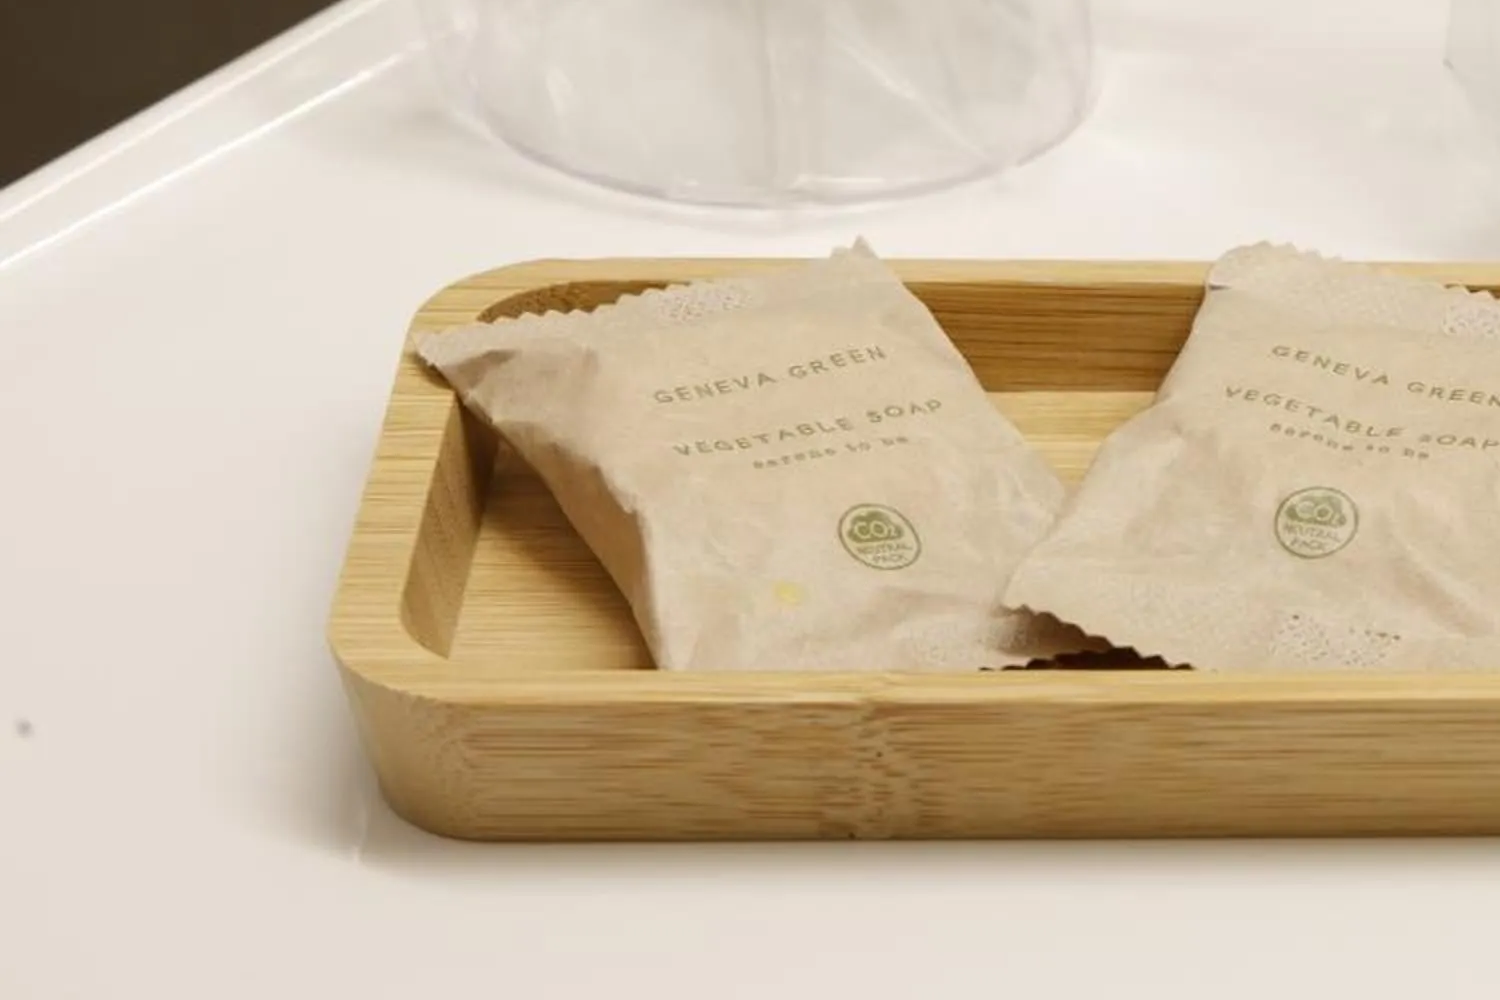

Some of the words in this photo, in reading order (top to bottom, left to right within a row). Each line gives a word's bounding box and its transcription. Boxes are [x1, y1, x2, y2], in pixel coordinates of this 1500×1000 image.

[652, 371, 777, 403] GENEVA
[787, 345, 888, 379] GREEN
[1271, 345, 1390, 385] GENEVA
[672, 416, 854, 457] VEGETABLE
[865, 398, 943, 424] SOAP
[1224, 386, 1407, 438] VEGETABLE
